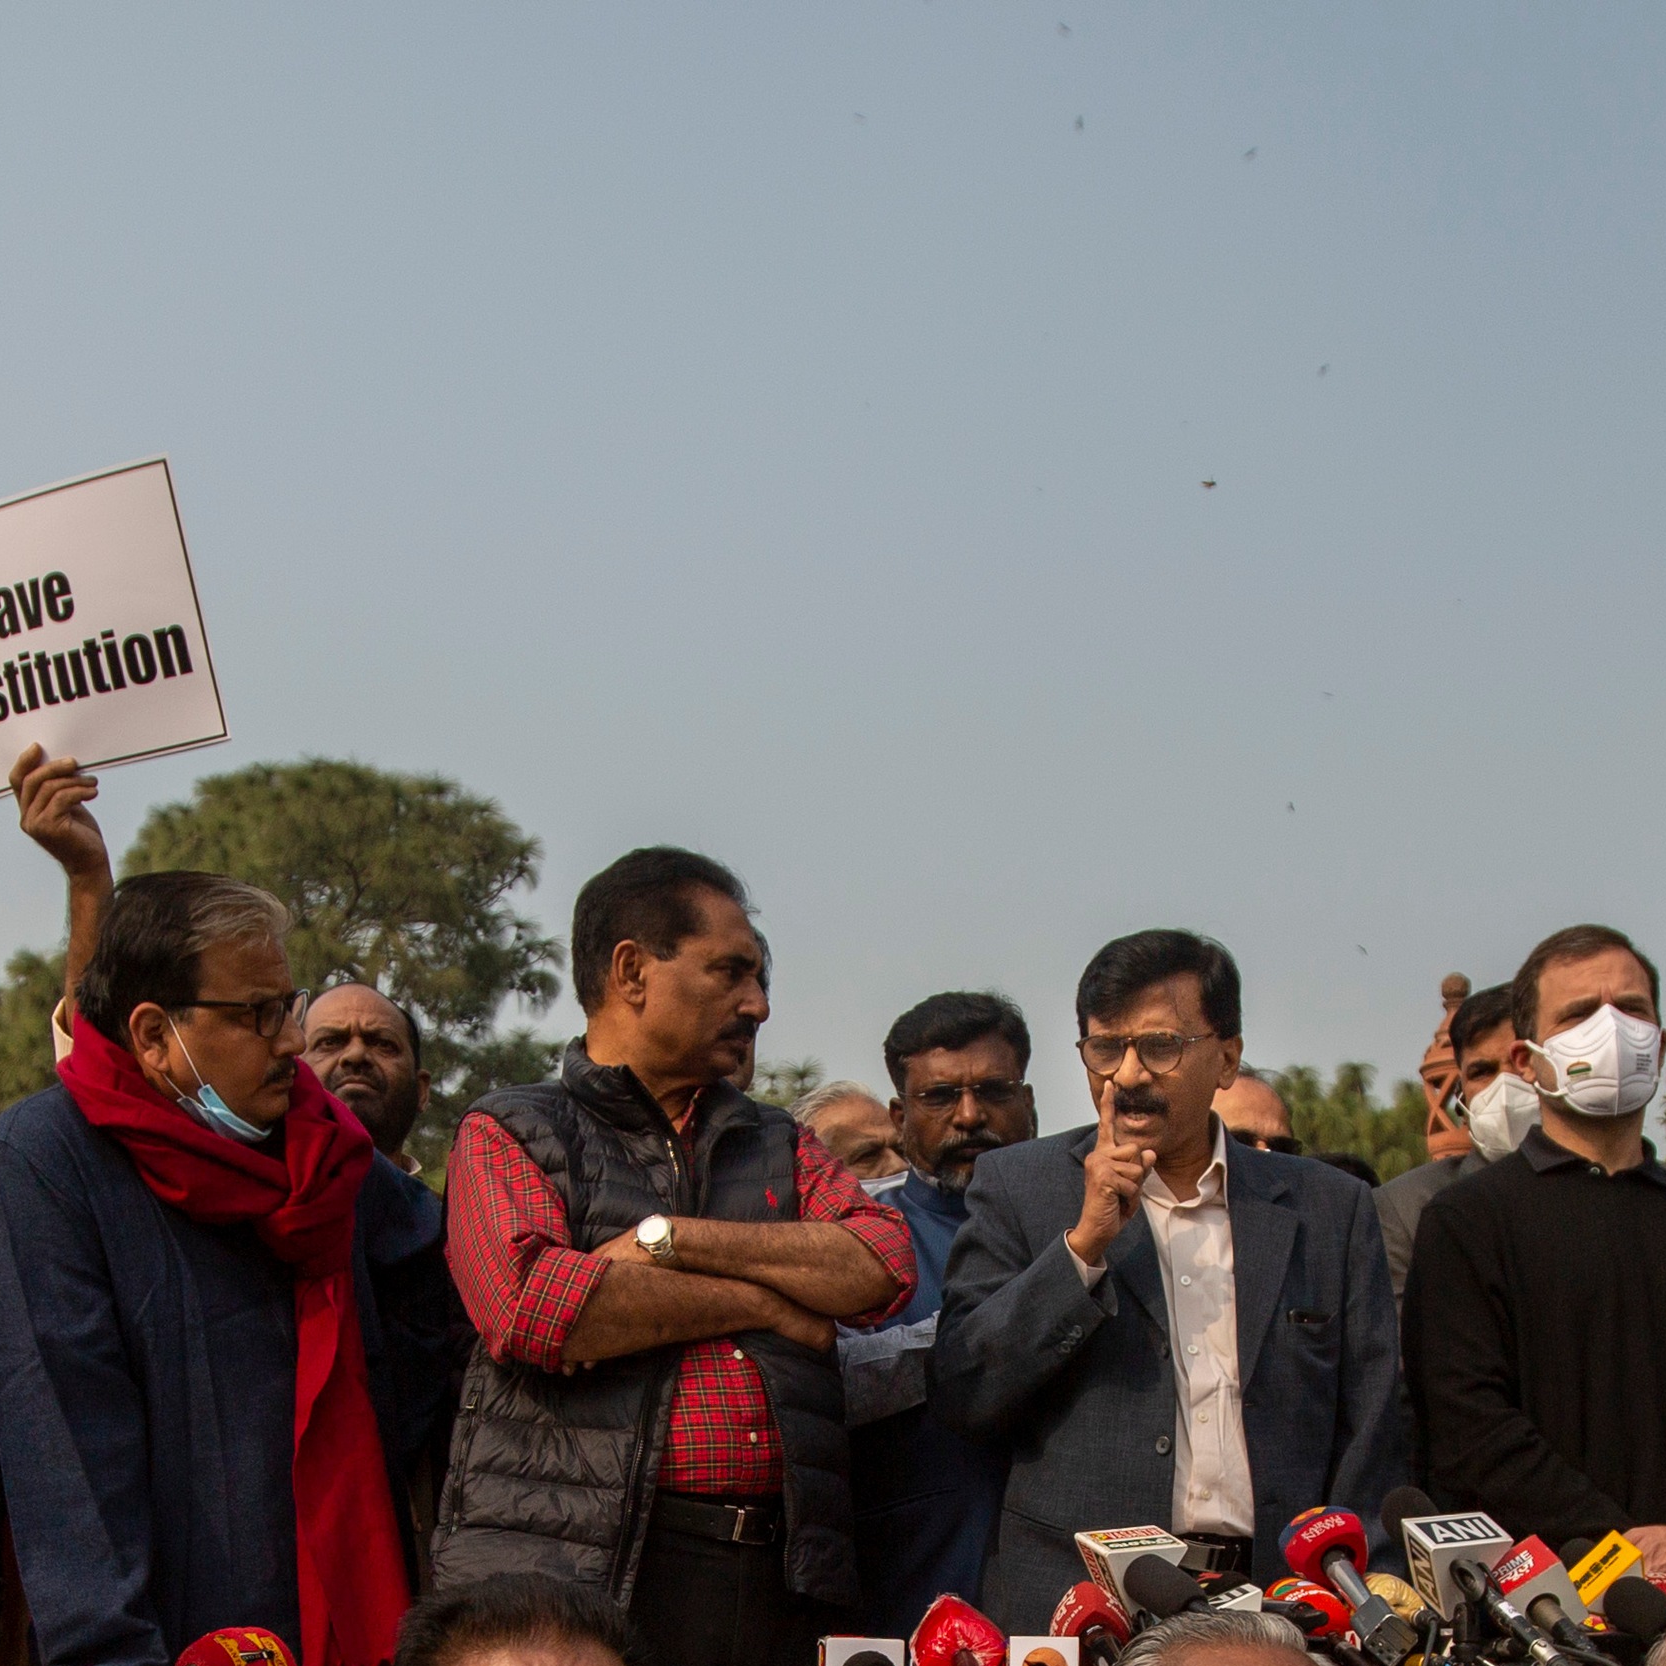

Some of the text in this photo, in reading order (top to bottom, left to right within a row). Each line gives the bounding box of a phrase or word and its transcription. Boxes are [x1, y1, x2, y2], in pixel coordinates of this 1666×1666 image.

[1430, 1517, 1495, 1543] ANI
[1411, 1540, 1439, 1605] ANI
[1493, 1549, 1534, 1578] PRIME
